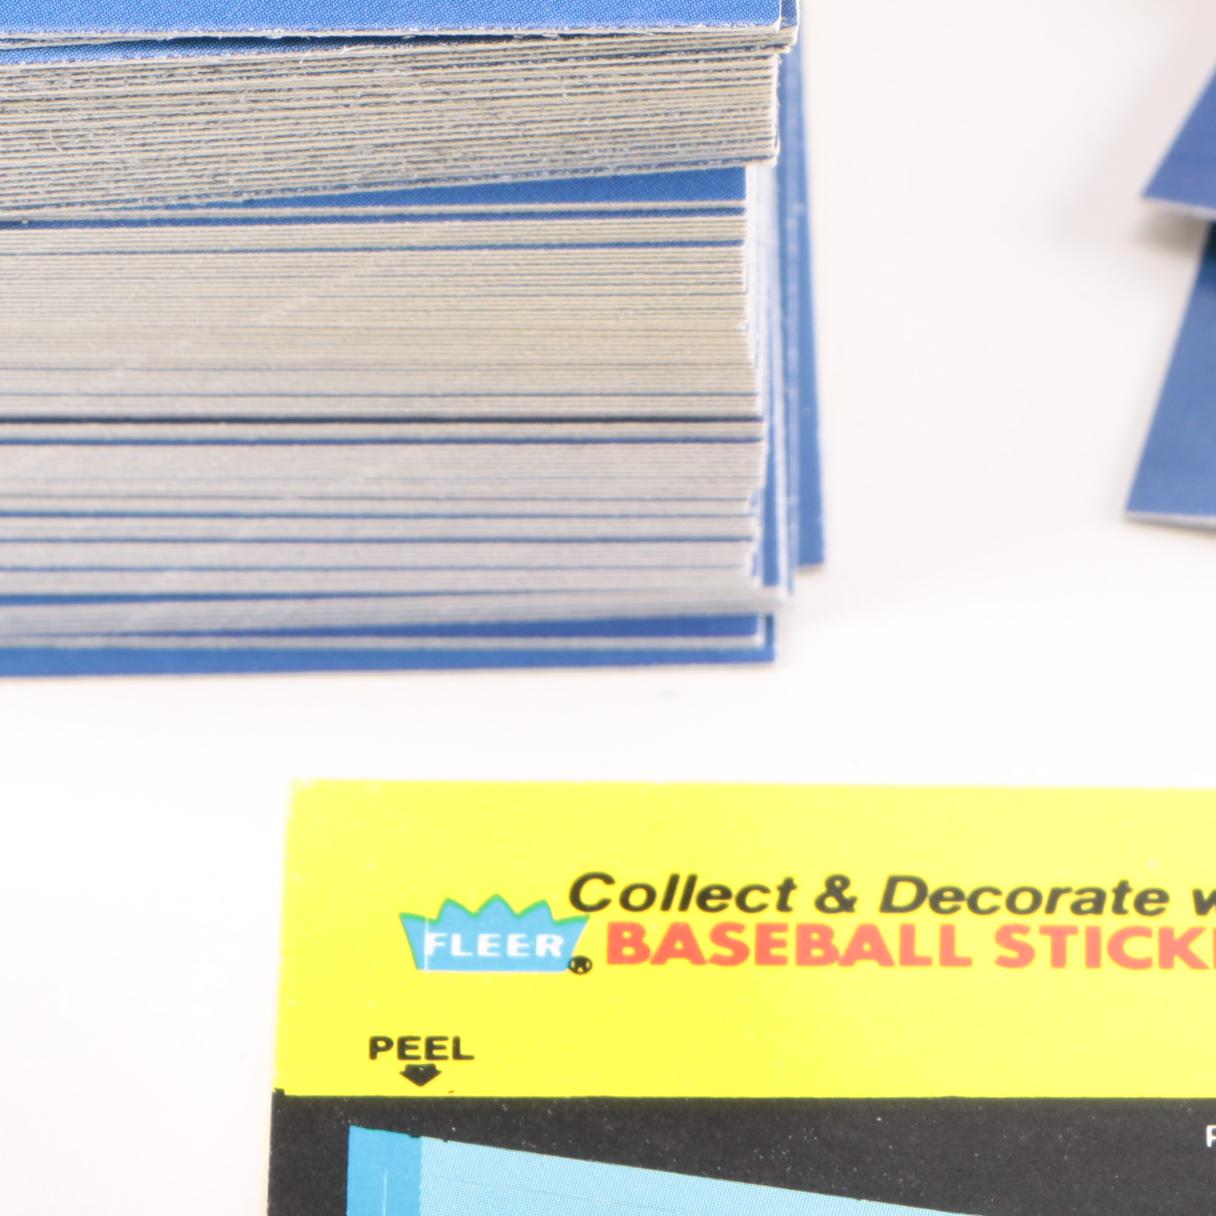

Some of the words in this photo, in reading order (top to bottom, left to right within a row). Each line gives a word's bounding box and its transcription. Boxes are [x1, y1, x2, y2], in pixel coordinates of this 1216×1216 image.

[569, 872, 797, 913] Collect
[814, 875, 857, 914] &
[879, 875, 1170, 916] Decorate
[424, 932, 566, 958] FLEER
[606, 921, 973, 967] BASEBALL
[369, 1036, 475, 1060] PEEL
